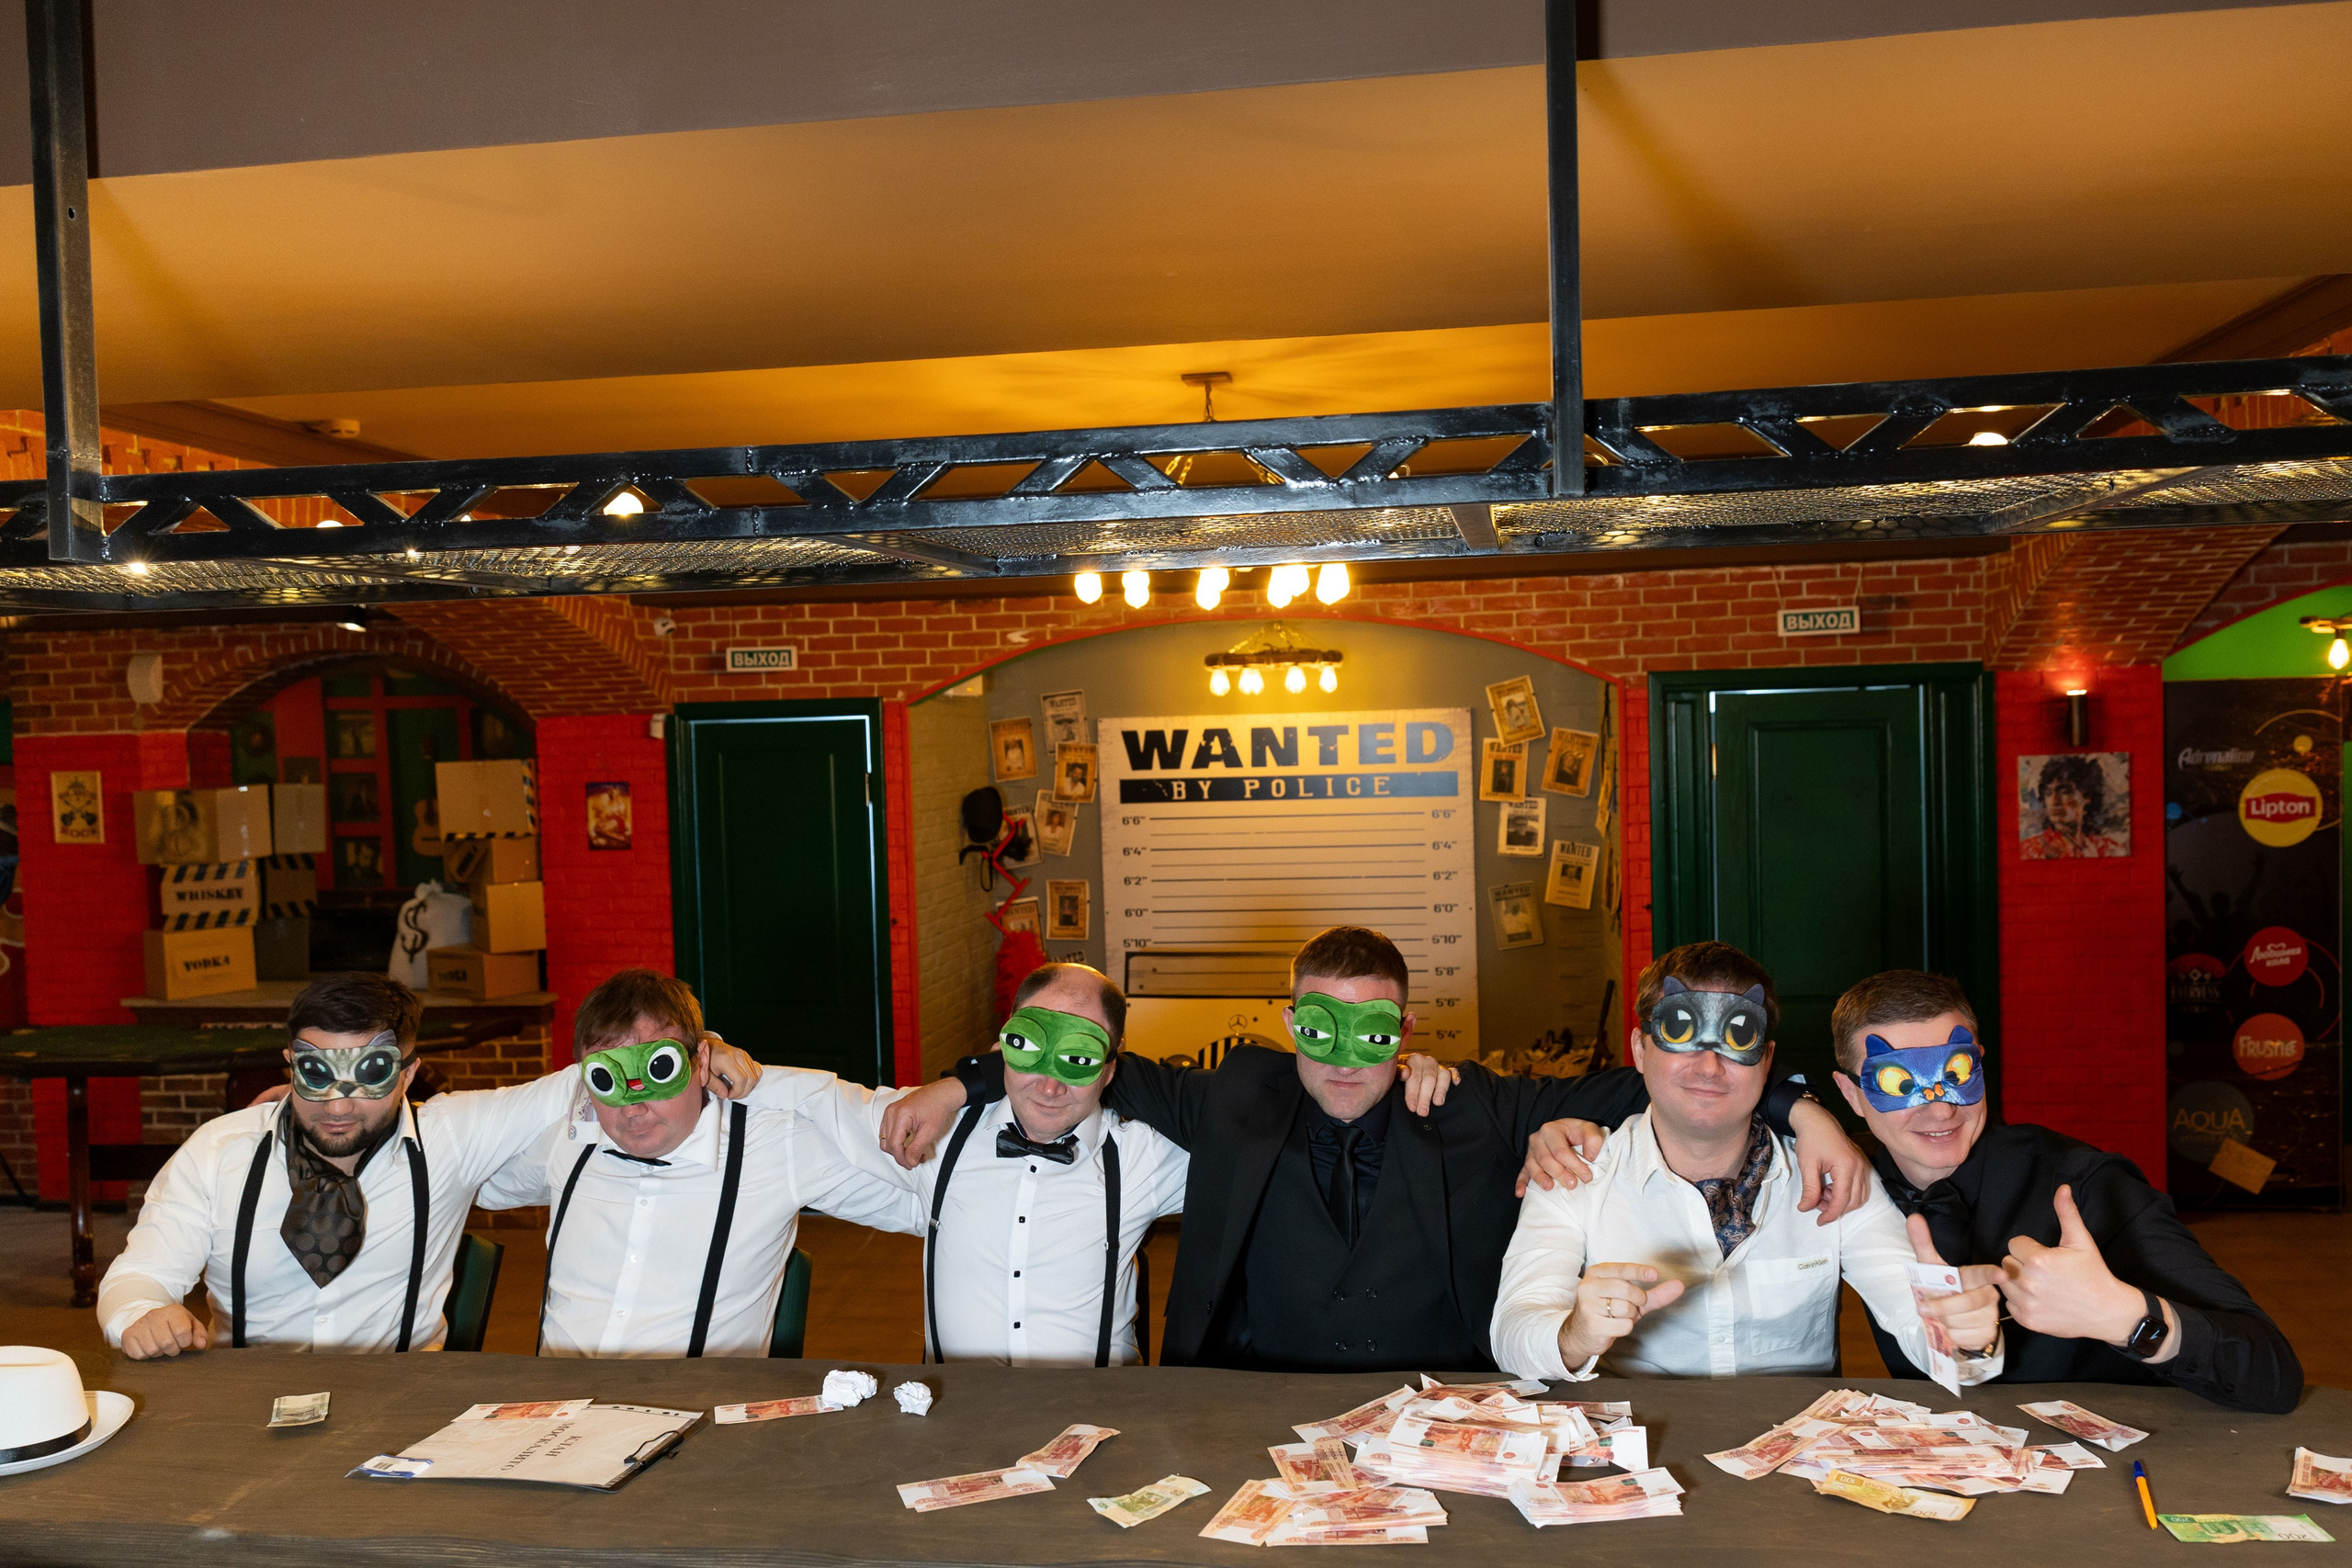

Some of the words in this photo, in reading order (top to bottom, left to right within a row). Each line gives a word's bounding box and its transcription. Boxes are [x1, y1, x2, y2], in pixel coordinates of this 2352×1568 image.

[1786, 613, 1852, 630] ВЫХОД
[733, 651, 791, 667] ВЫХОД
[1120, 721, 1455, 772] WANTED
[1171, 780, 1212, 800] BY
[1244, 776, 1391, 798] POLICE
[2250, 798, 2311, 818] Lipton
[1560, 842, 1593, 858] WANTED
[175, 887, 243, 901] WHISKEY
[184, 956, 230, 972] VODKA
[2172, 1108, 2246, 1132] AQUA
[500, 1421, 576, 1471] МОСКАЛИТО
[545, 1435, 582, 1457] КЛАН
[1839, 1475, 1856, 1483] 100
